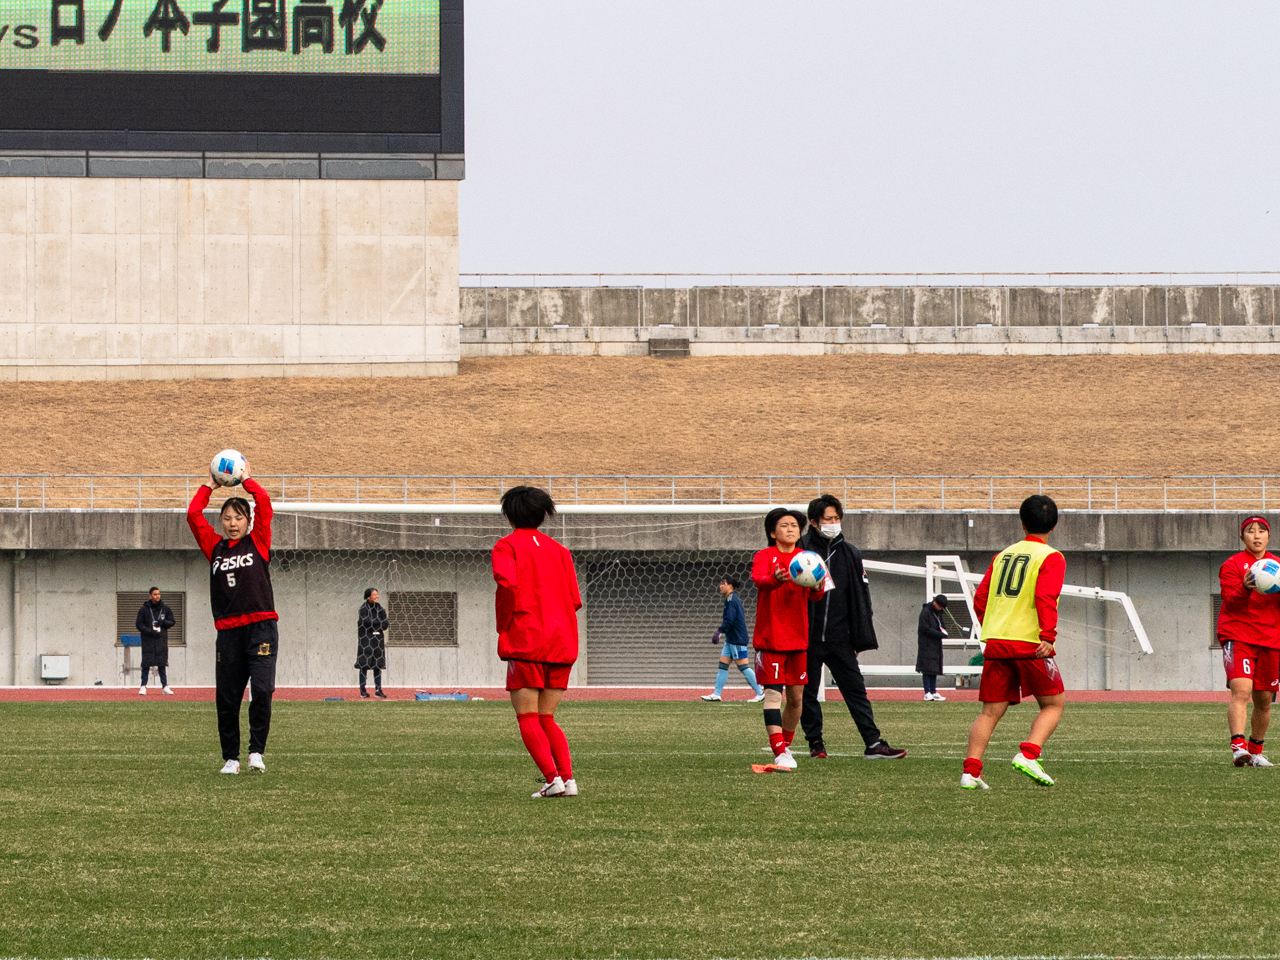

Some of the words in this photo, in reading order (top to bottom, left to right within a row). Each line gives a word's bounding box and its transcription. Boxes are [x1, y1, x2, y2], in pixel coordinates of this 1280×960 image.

[220, 553, 253, 571] asics
[226, 572, 236, 587] 5
[995, 553, 1031, 598] 10
[772, 662, 779, 679] 7
[1242, 658, 1251, 674] 6
